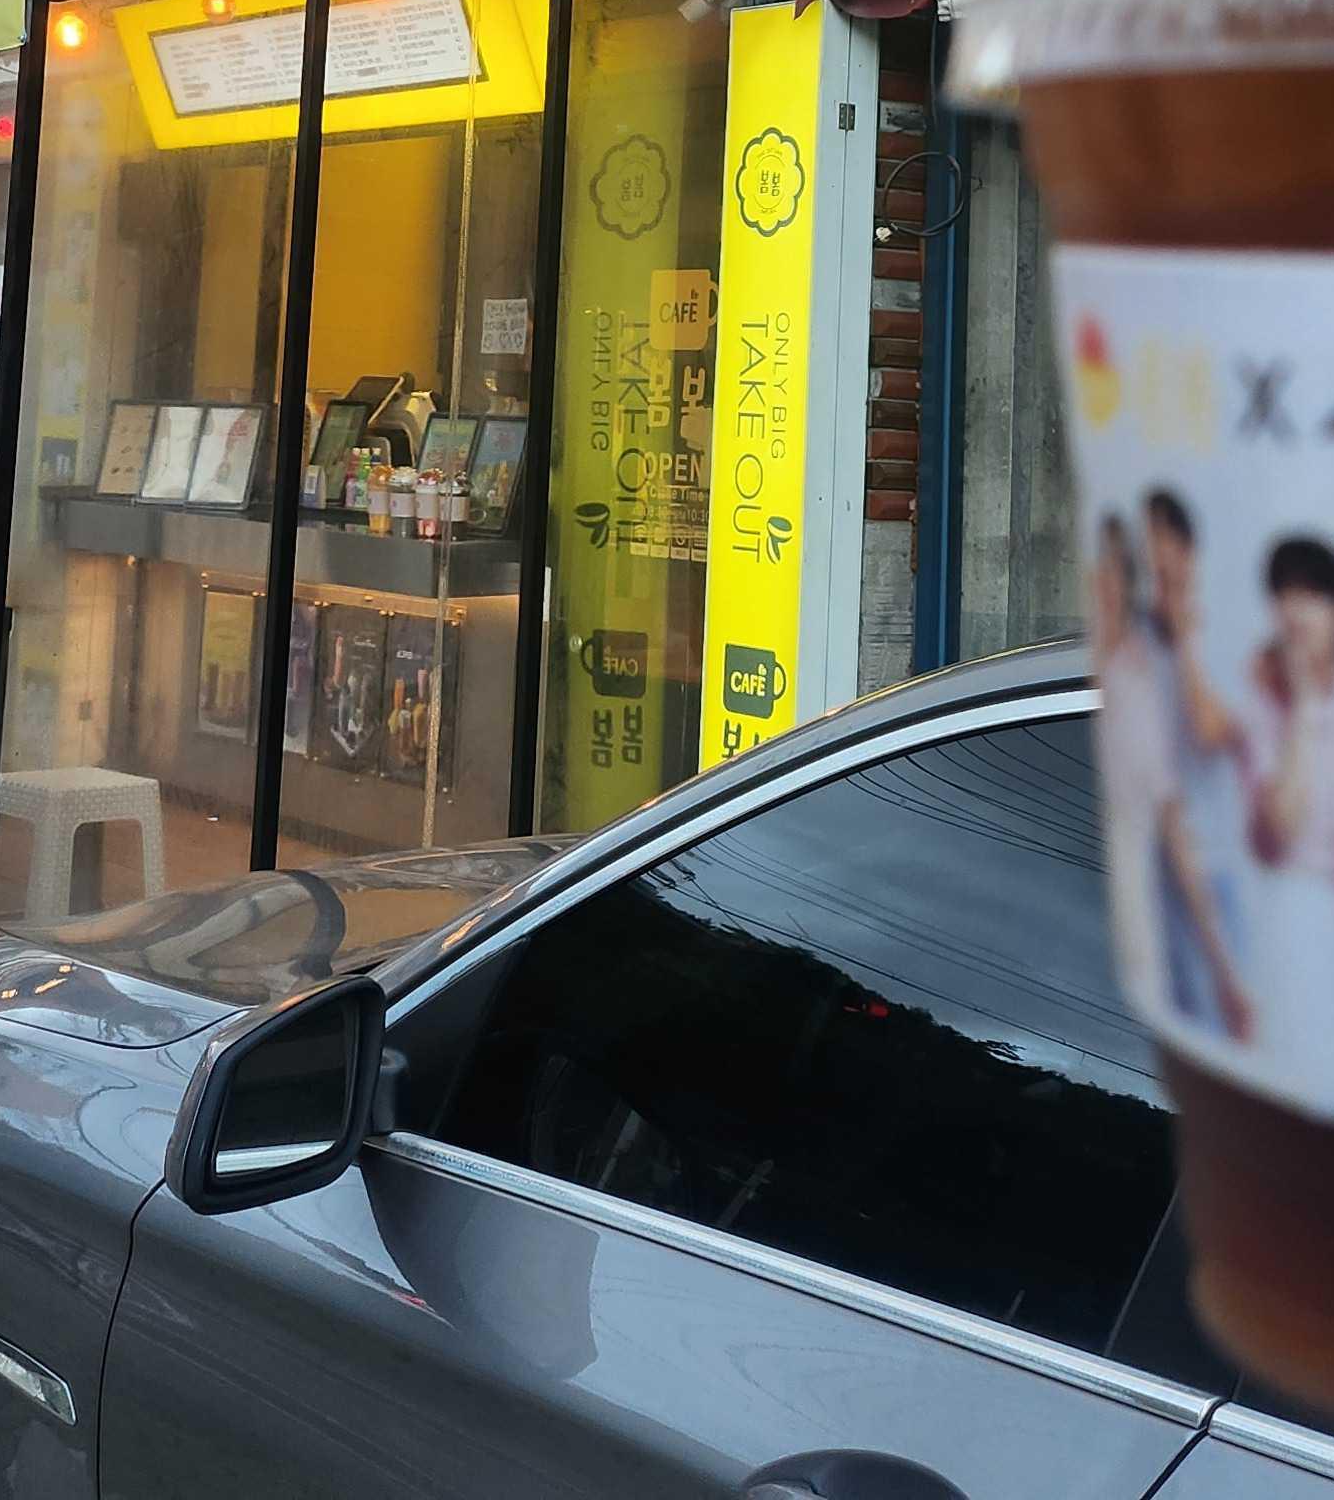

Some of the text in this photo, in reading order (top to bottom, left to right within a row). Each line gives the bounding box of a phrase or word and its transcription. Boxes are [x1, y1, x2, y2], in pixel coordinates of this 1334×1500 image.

[658, 302, 699, 324] CAFE
[770, 311, 791, 460] ONLY BIG
[732, 313, 769, 564] TAKE OUT
[644, 451, 702, 483] OPEN
[730, 670, 767, 697] CAFE
